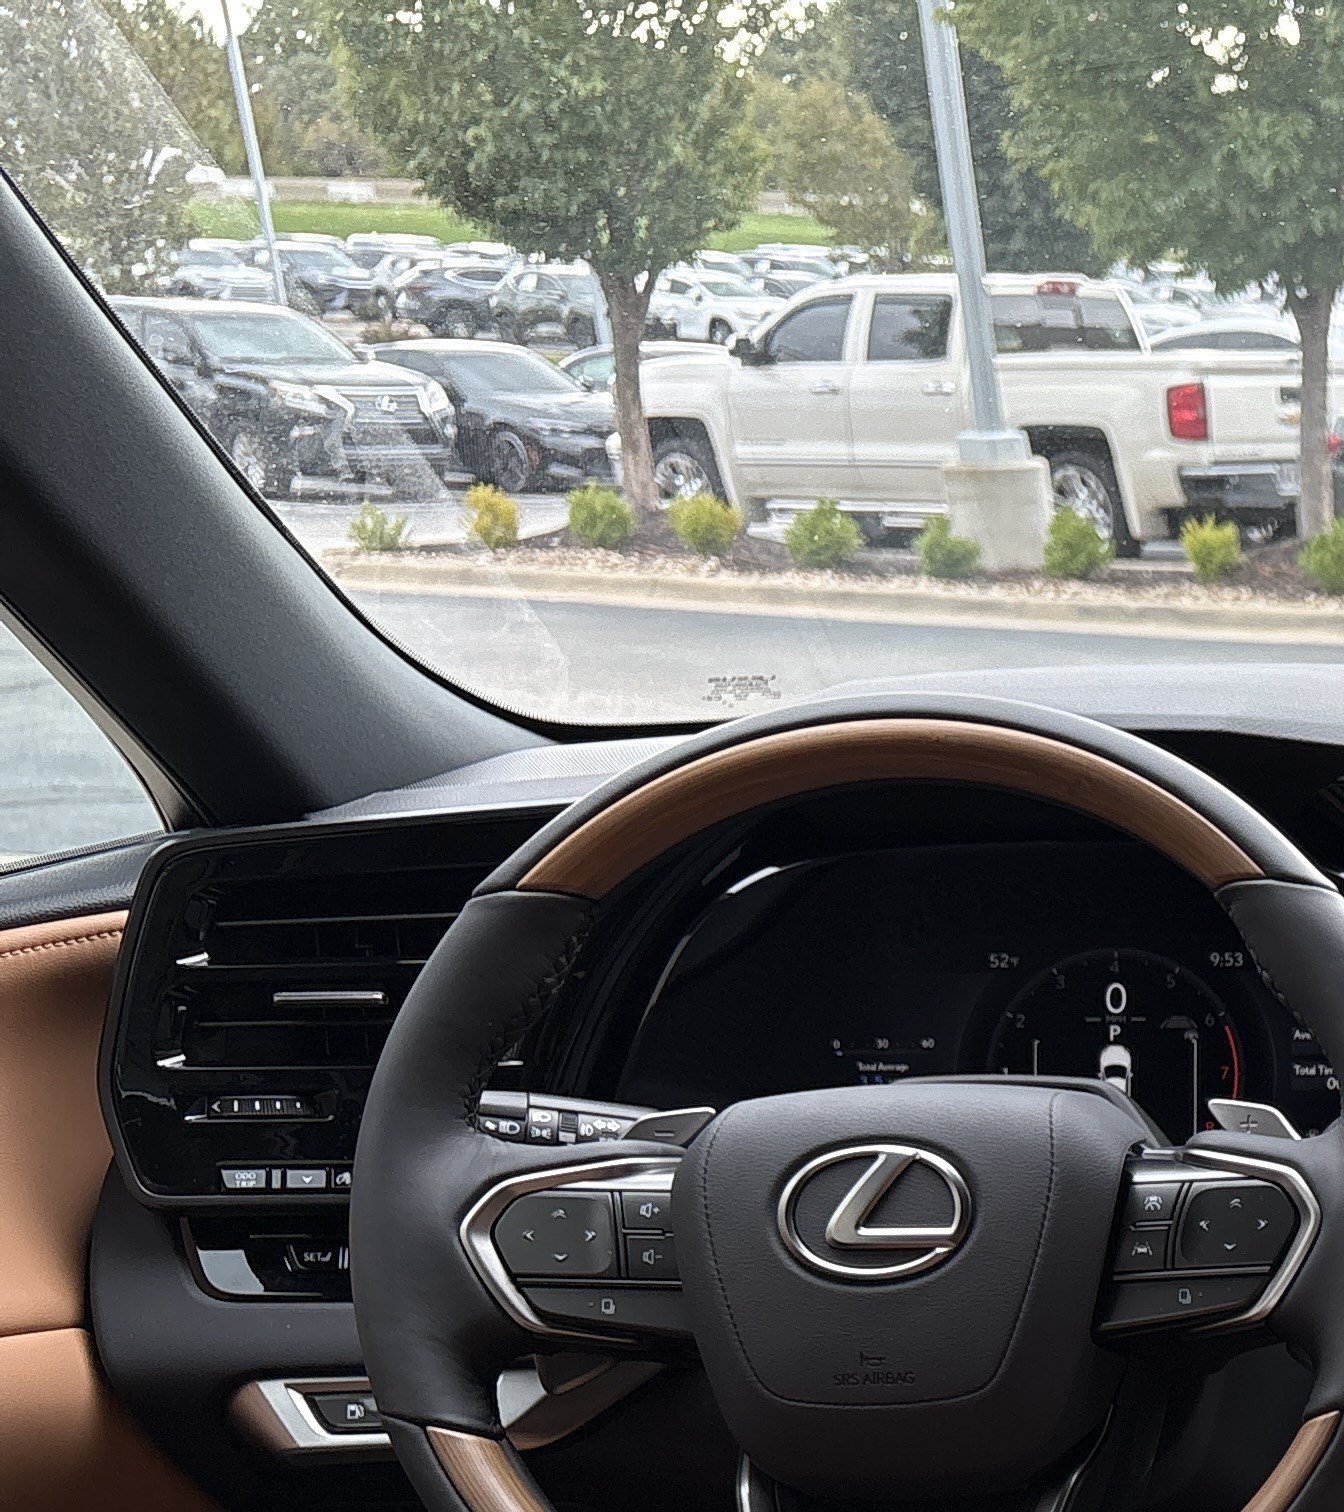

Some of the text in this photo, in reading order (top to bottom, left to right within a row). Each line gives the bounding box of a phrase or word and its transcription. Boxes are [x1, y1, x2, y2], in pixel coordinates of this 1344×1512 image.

[1208, 951, 1245, 969] 9:53
[1055, 974, 1066, 990] 3
[1165, 974, 1177, 990] 5
[1105, 981, 1128, 1015] 0
[1014, 1013, 1026, 1029] 2
[1203, 1010, 1216, 1026] 6
[1108, 1024, 1122, 1042] P
[234, 1171, 257, 1180] ODO
[833, 1370, 917, 1386] SRS AIRBAG
